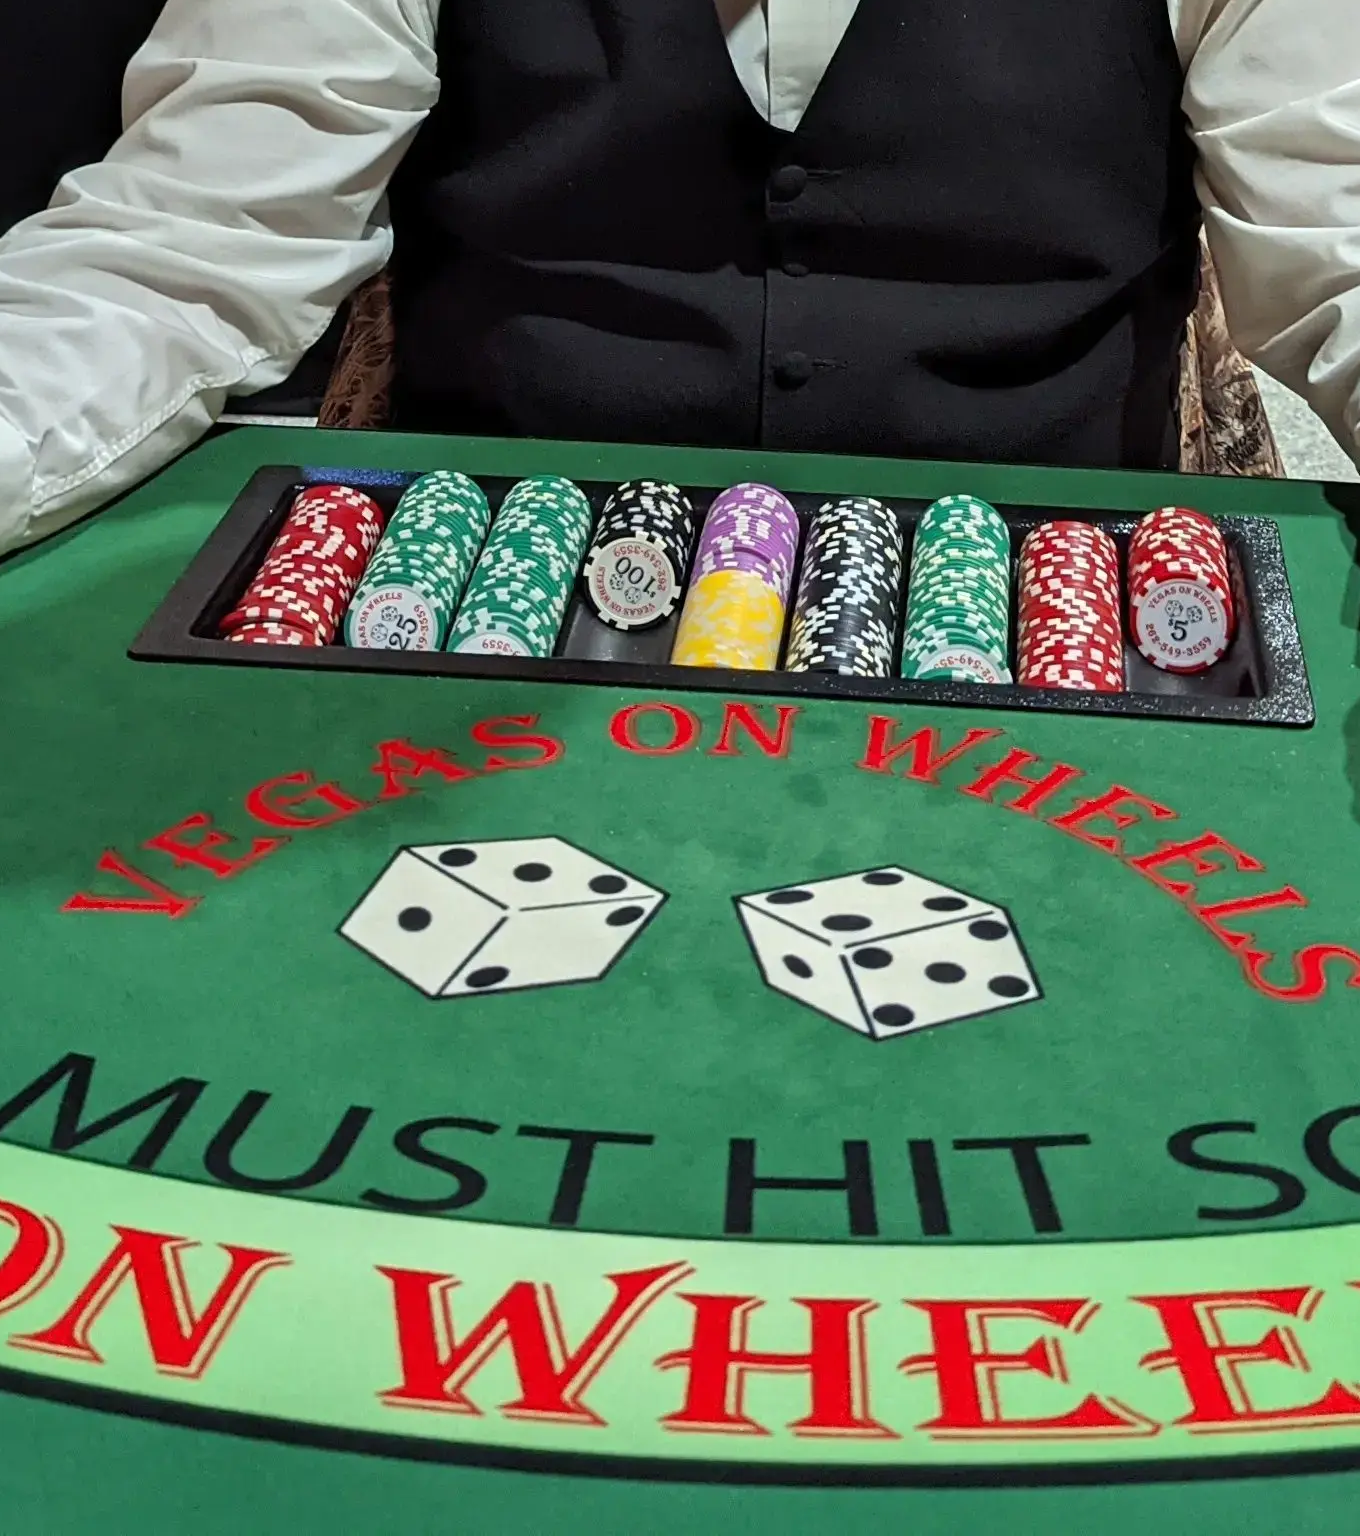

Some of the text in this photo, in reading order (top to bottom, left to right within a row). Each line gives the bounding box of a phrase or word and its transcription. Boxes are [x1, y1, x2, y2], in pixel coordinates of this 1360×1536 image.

[1148, 586, 1177, 609] VEGAS
[59, 711, 566, 920] VEGAS
[607, 700, 805, 760] ON
[723, 1132, 1092, 1237] HIT
